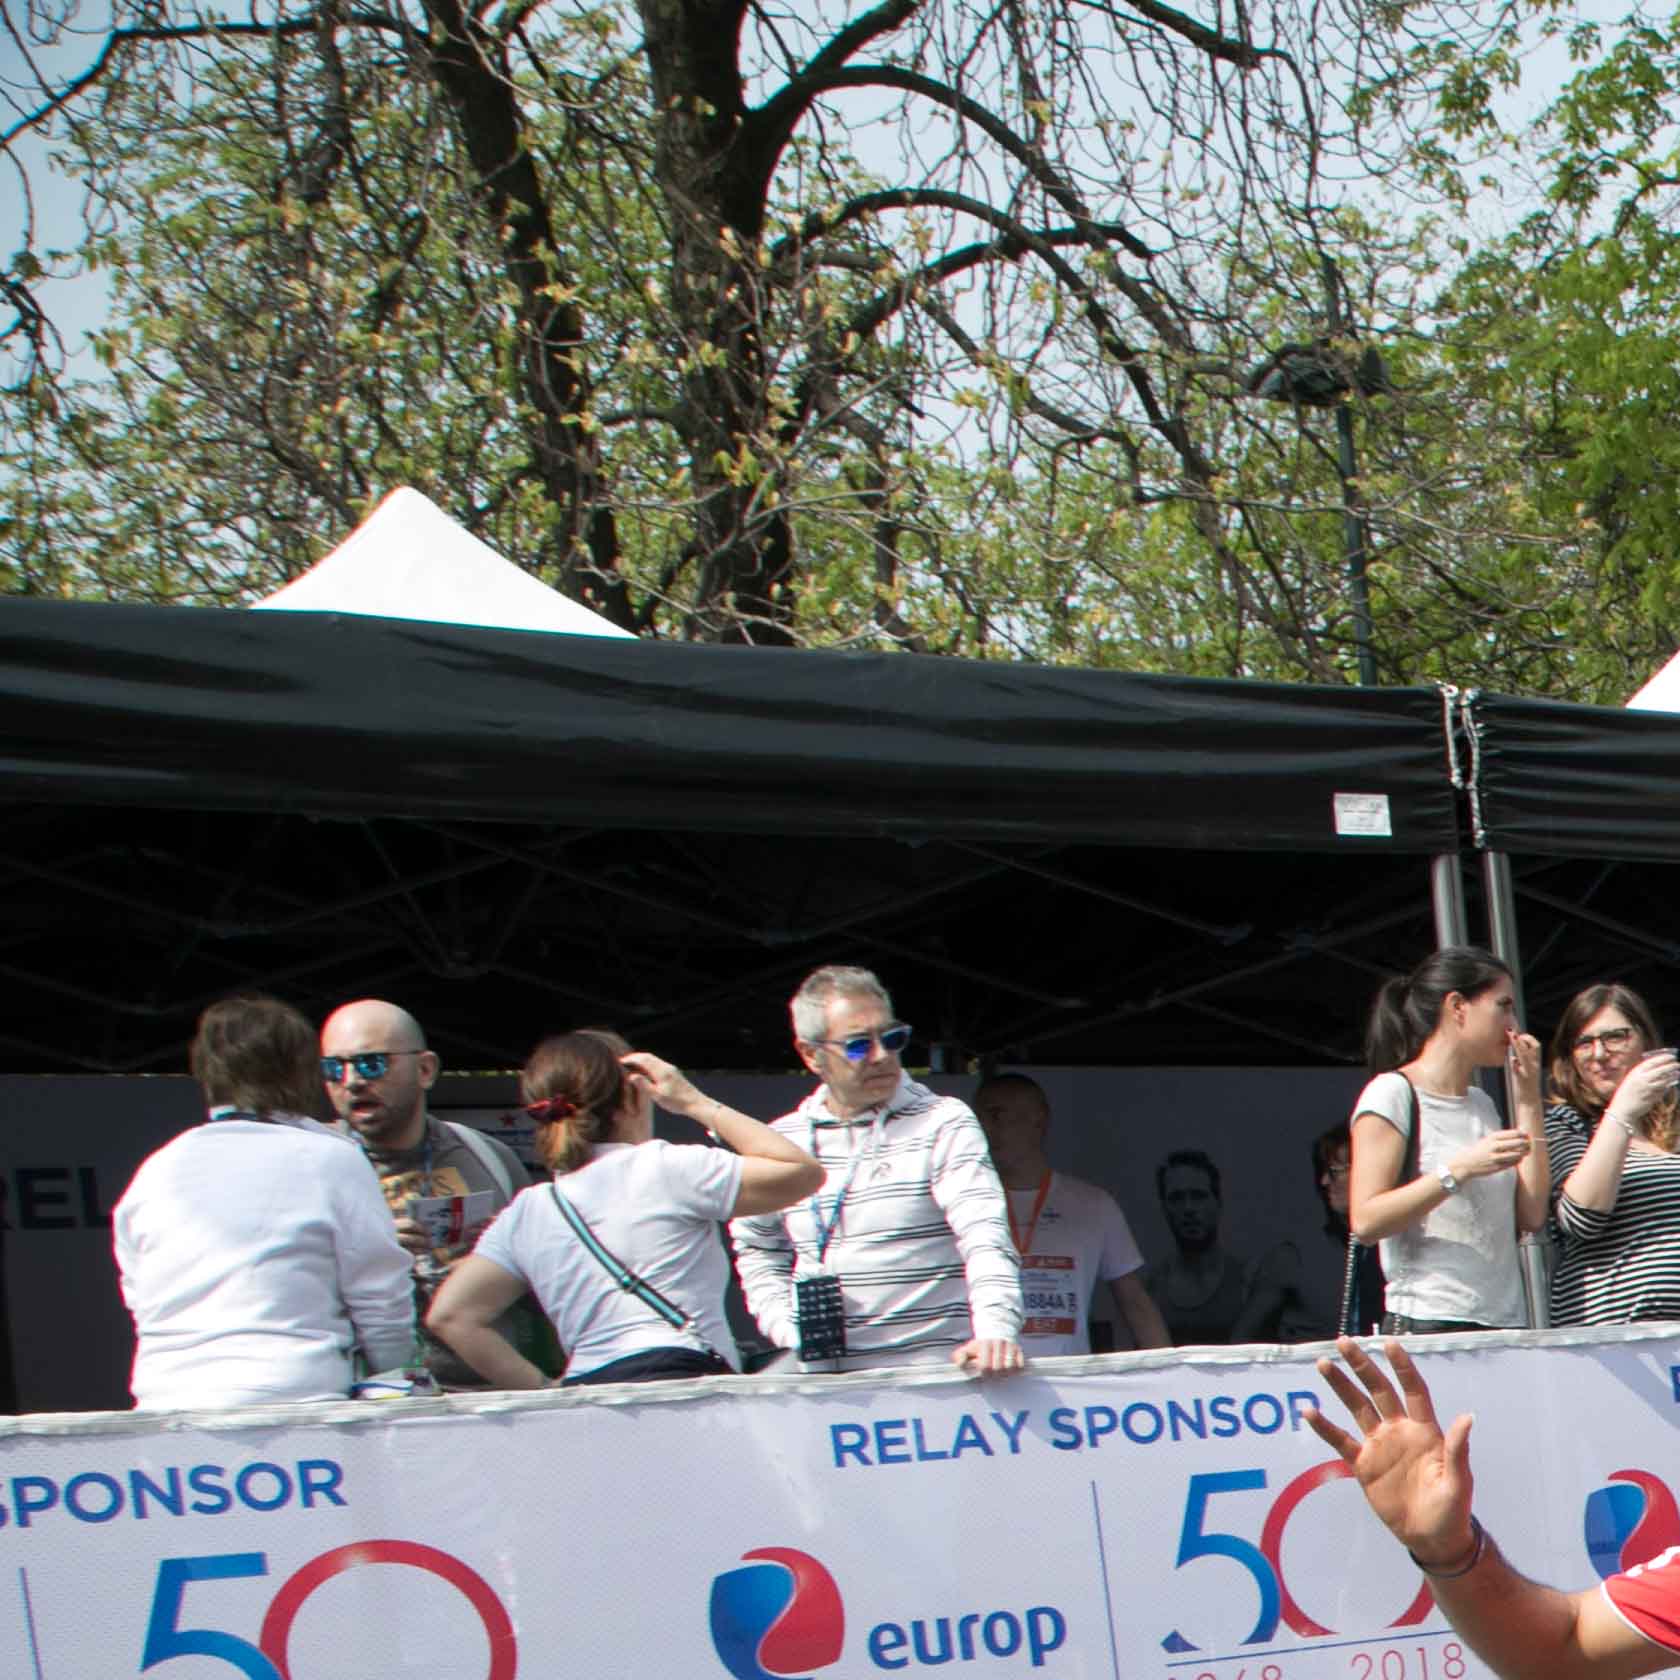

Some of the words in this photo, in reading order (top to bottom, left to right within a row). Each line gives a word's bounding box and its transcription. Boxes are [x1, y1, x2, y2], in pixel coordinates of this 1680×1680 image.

[831, 1406, 1030, 1468] RELAY
[1160, 1460, 1436, 1653] 50
[868, 1606, 1068, 1671] europ
